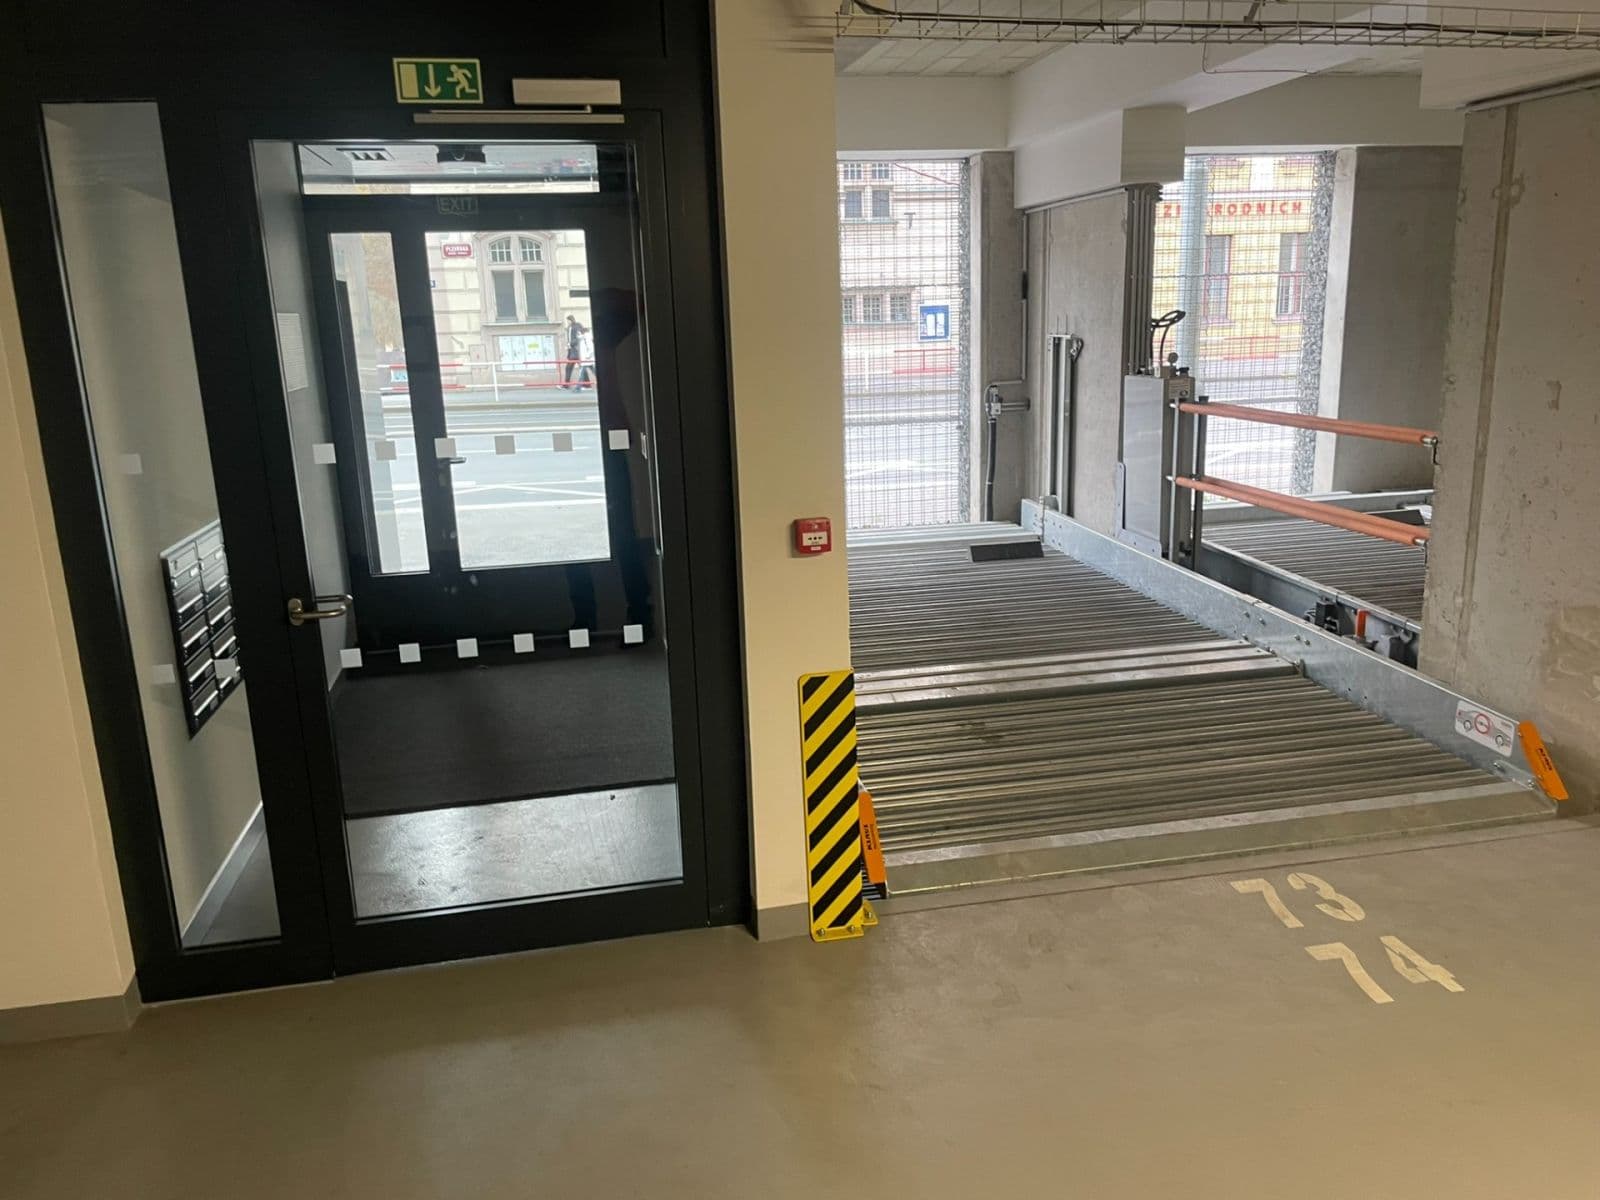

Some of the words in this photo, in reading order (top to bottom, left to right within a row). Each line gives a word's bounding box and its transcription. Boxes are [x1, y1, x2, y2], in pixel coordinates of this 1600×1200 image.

[440, 197, 473, 211] EXIT
[1230, 872, 1366, 928] 73
[1304, 935, 1465, 1004] 74
